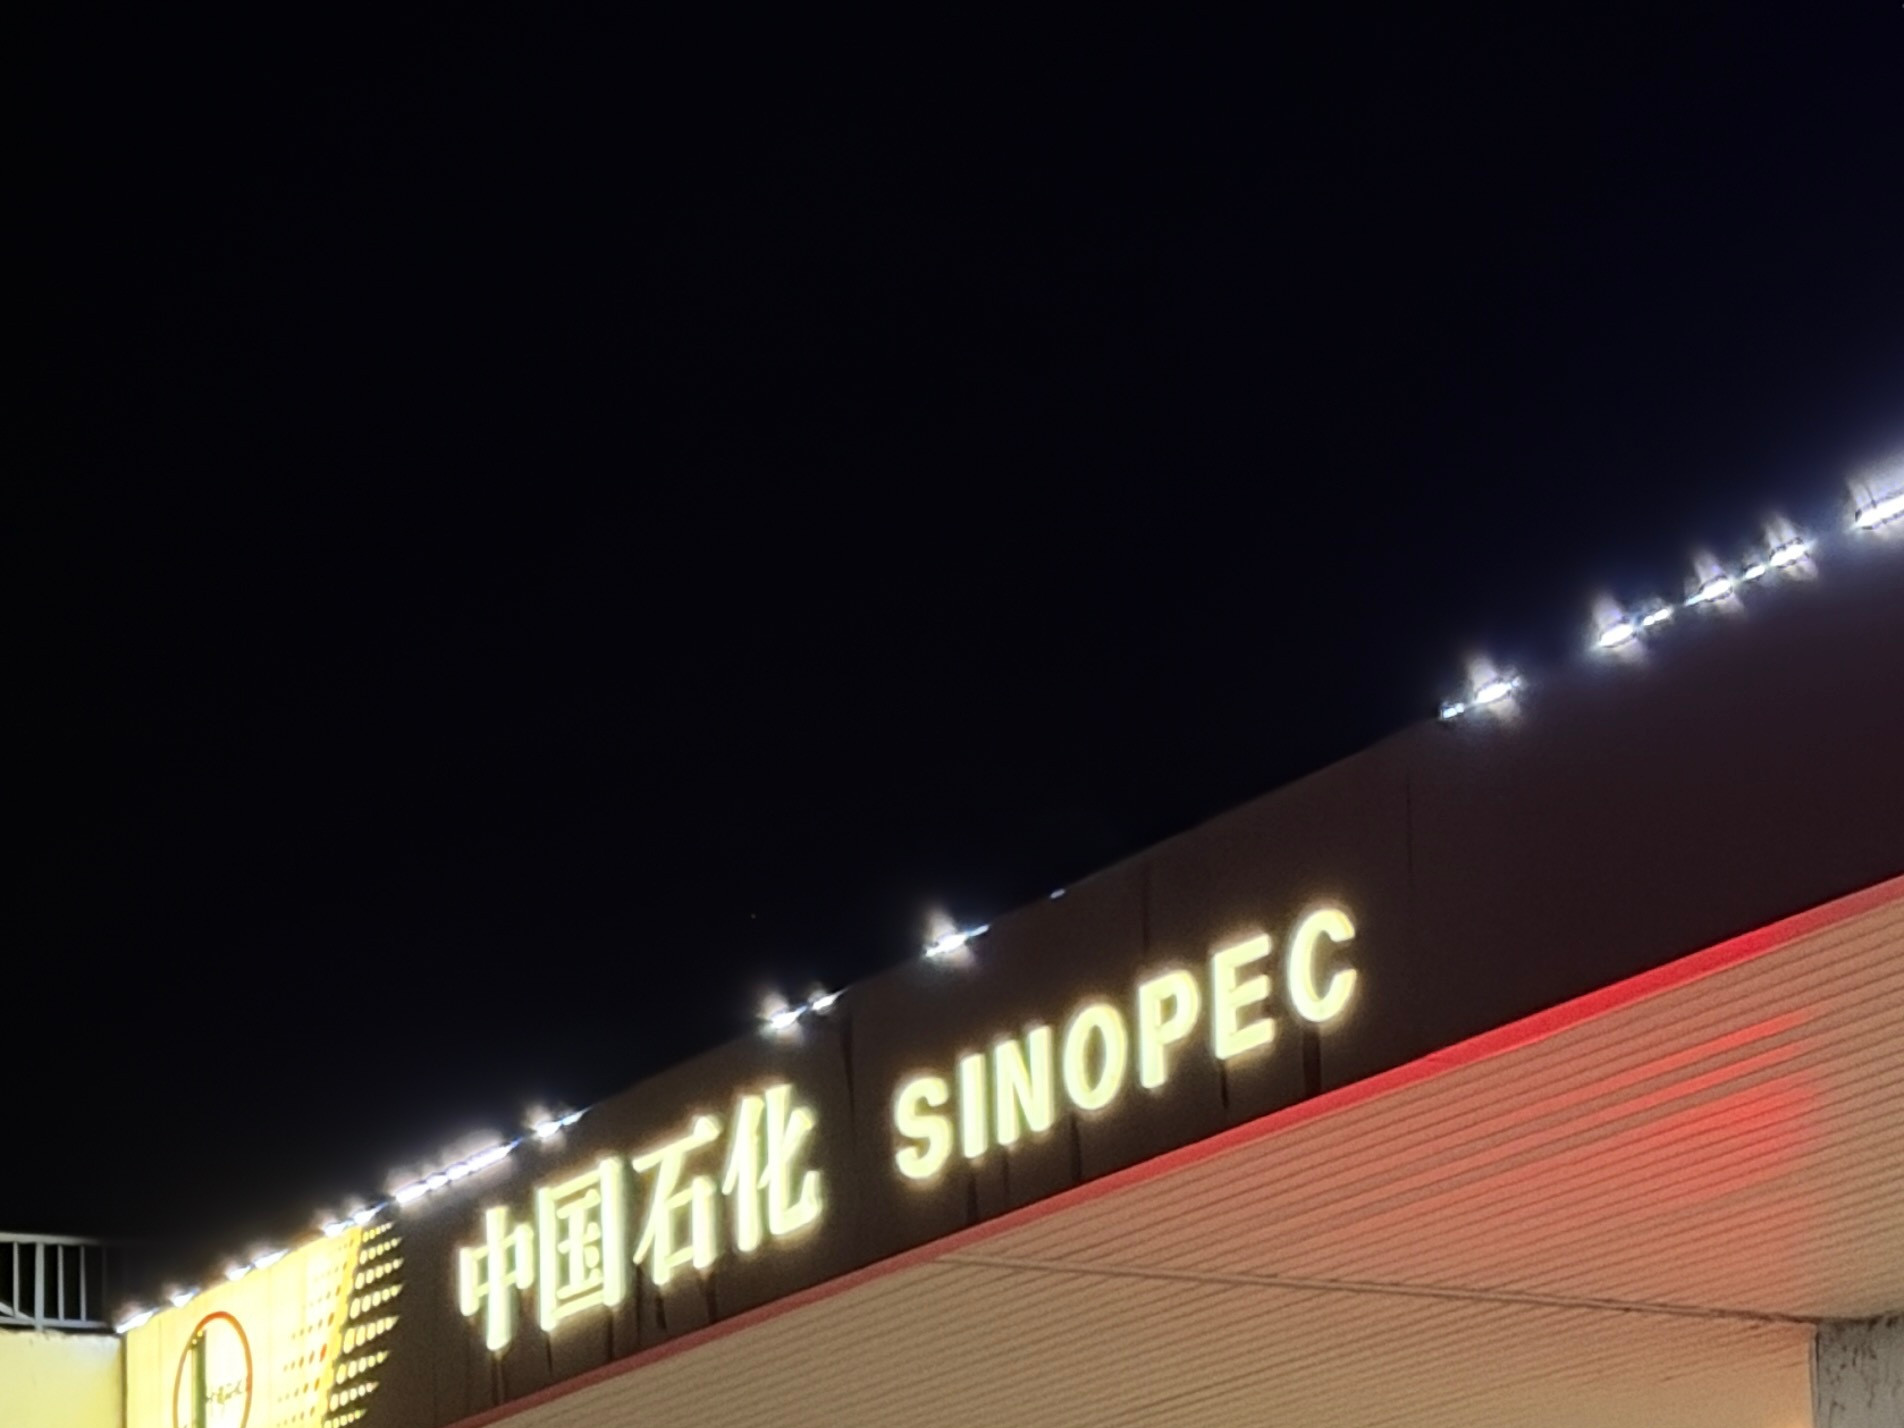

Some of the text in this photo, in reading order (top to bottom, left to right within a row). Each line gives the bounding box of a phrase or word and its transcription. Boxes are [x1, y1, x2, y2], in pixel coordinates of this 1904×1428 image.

[894, 908, 1357, 1179] SINOPEC
[459, 1083, 823, 1350] 中国石化
